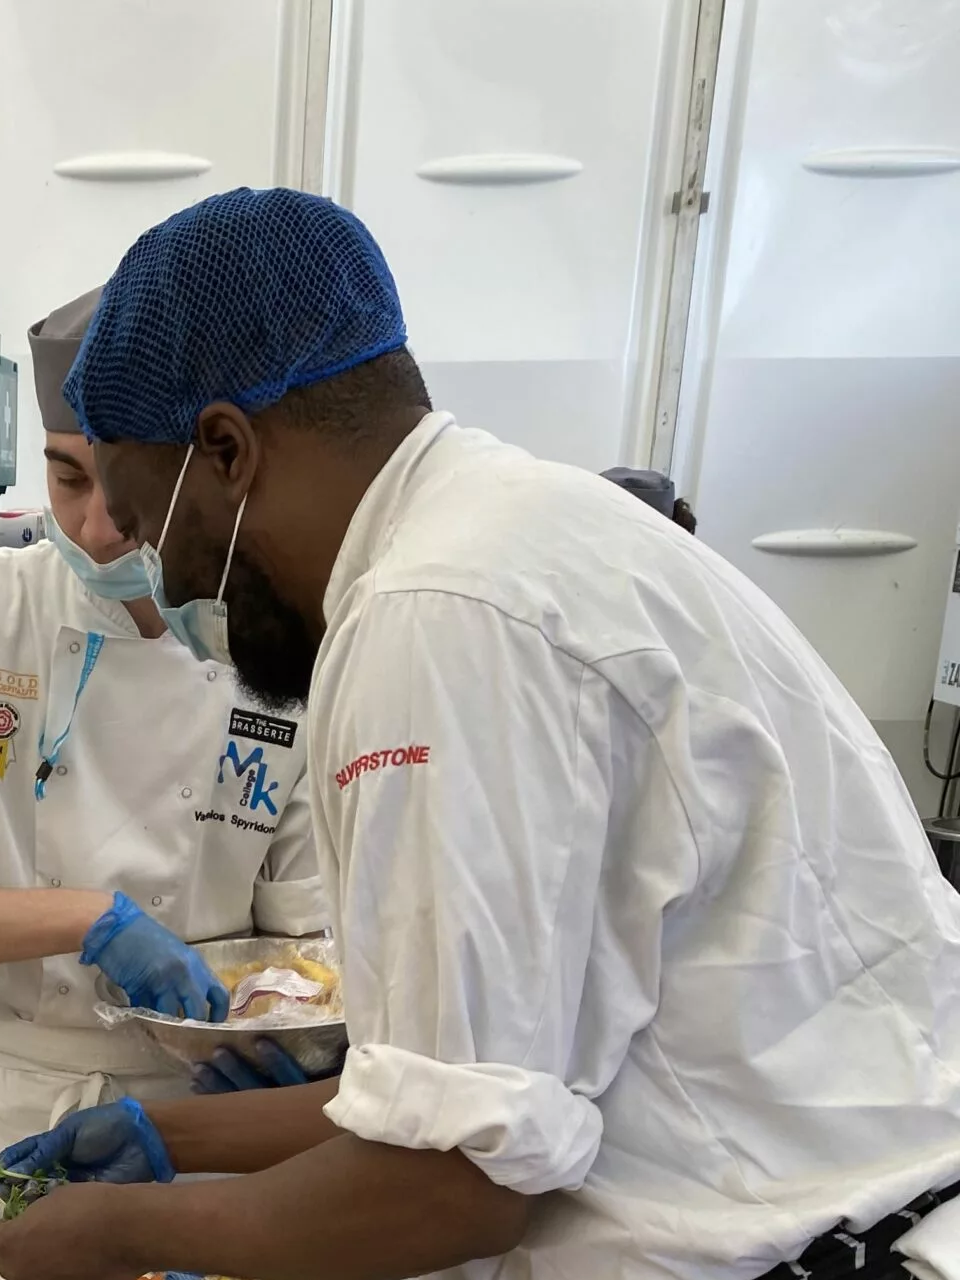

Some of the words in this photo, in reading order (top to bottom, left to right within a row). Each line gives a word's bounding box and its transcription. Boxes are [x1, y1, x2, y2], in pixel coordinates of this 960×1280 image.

[231, 720, 292, 743] BRASSERIE
[255, 718, 268, 728] THE
[239, 769, 256, 807] College
